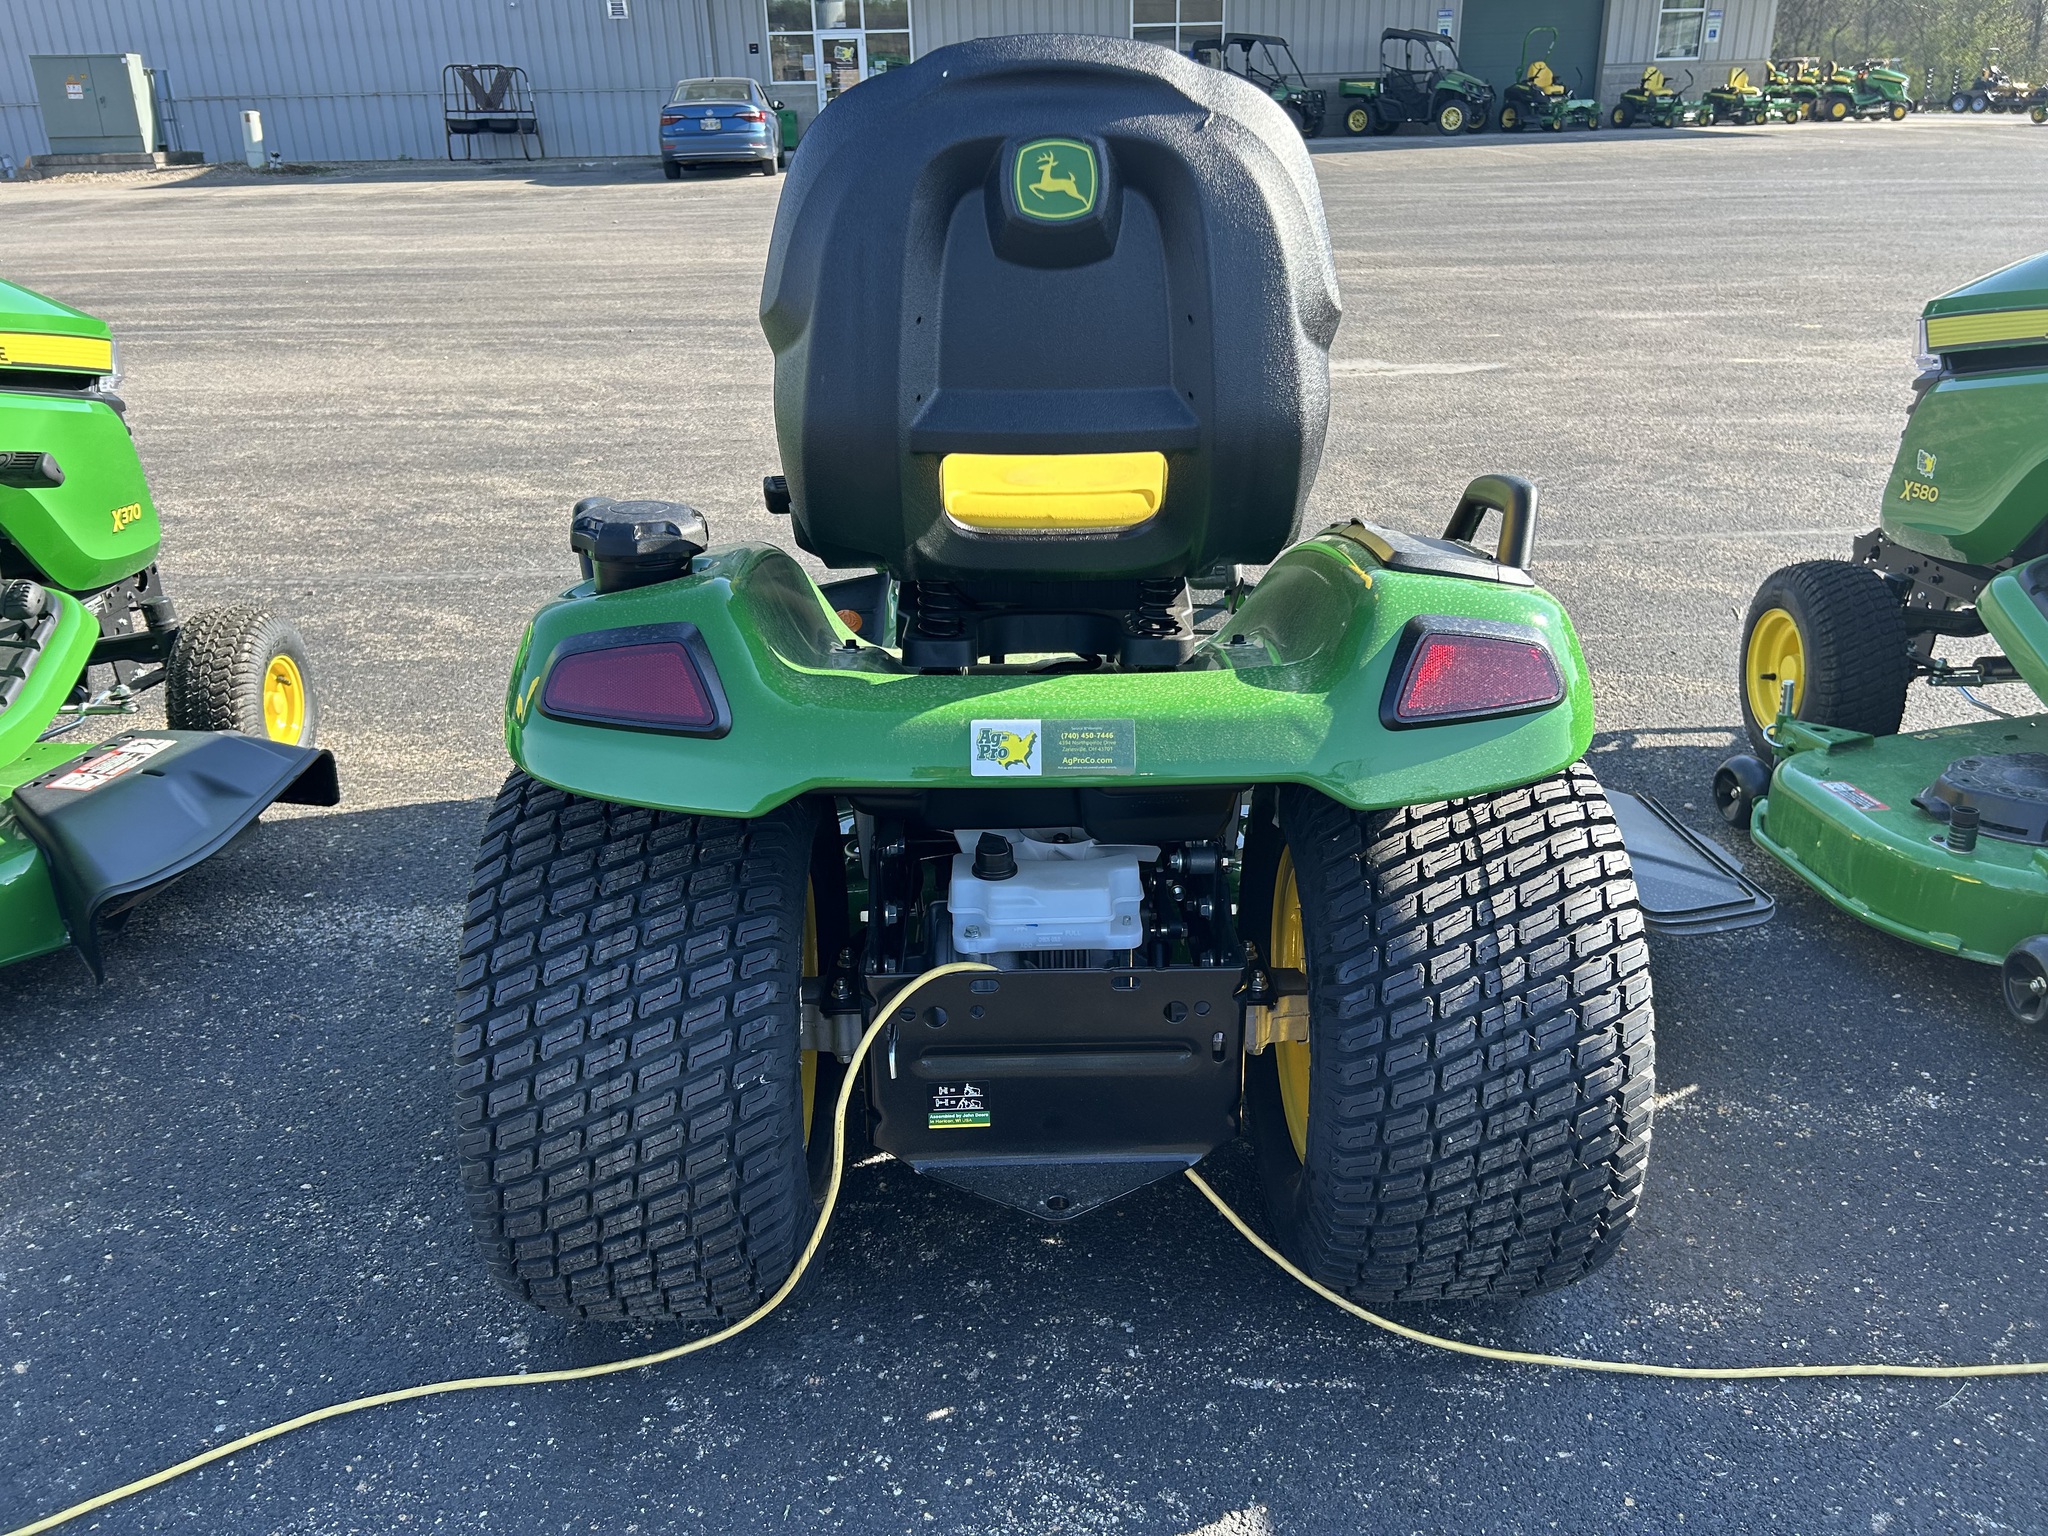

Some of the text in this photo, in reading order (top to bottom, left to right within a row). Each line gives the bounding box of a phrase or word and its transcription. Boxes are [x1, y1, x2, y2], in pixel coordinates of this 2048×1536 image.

[1900, 480, 1939, 503] X580
[111, 503, 142, 534] X370
[978, 729, 1008, 747] Ag-
[978, 745, 1009, 760] Pro
[1062, 757, 1113, 765] AgProCo.com
